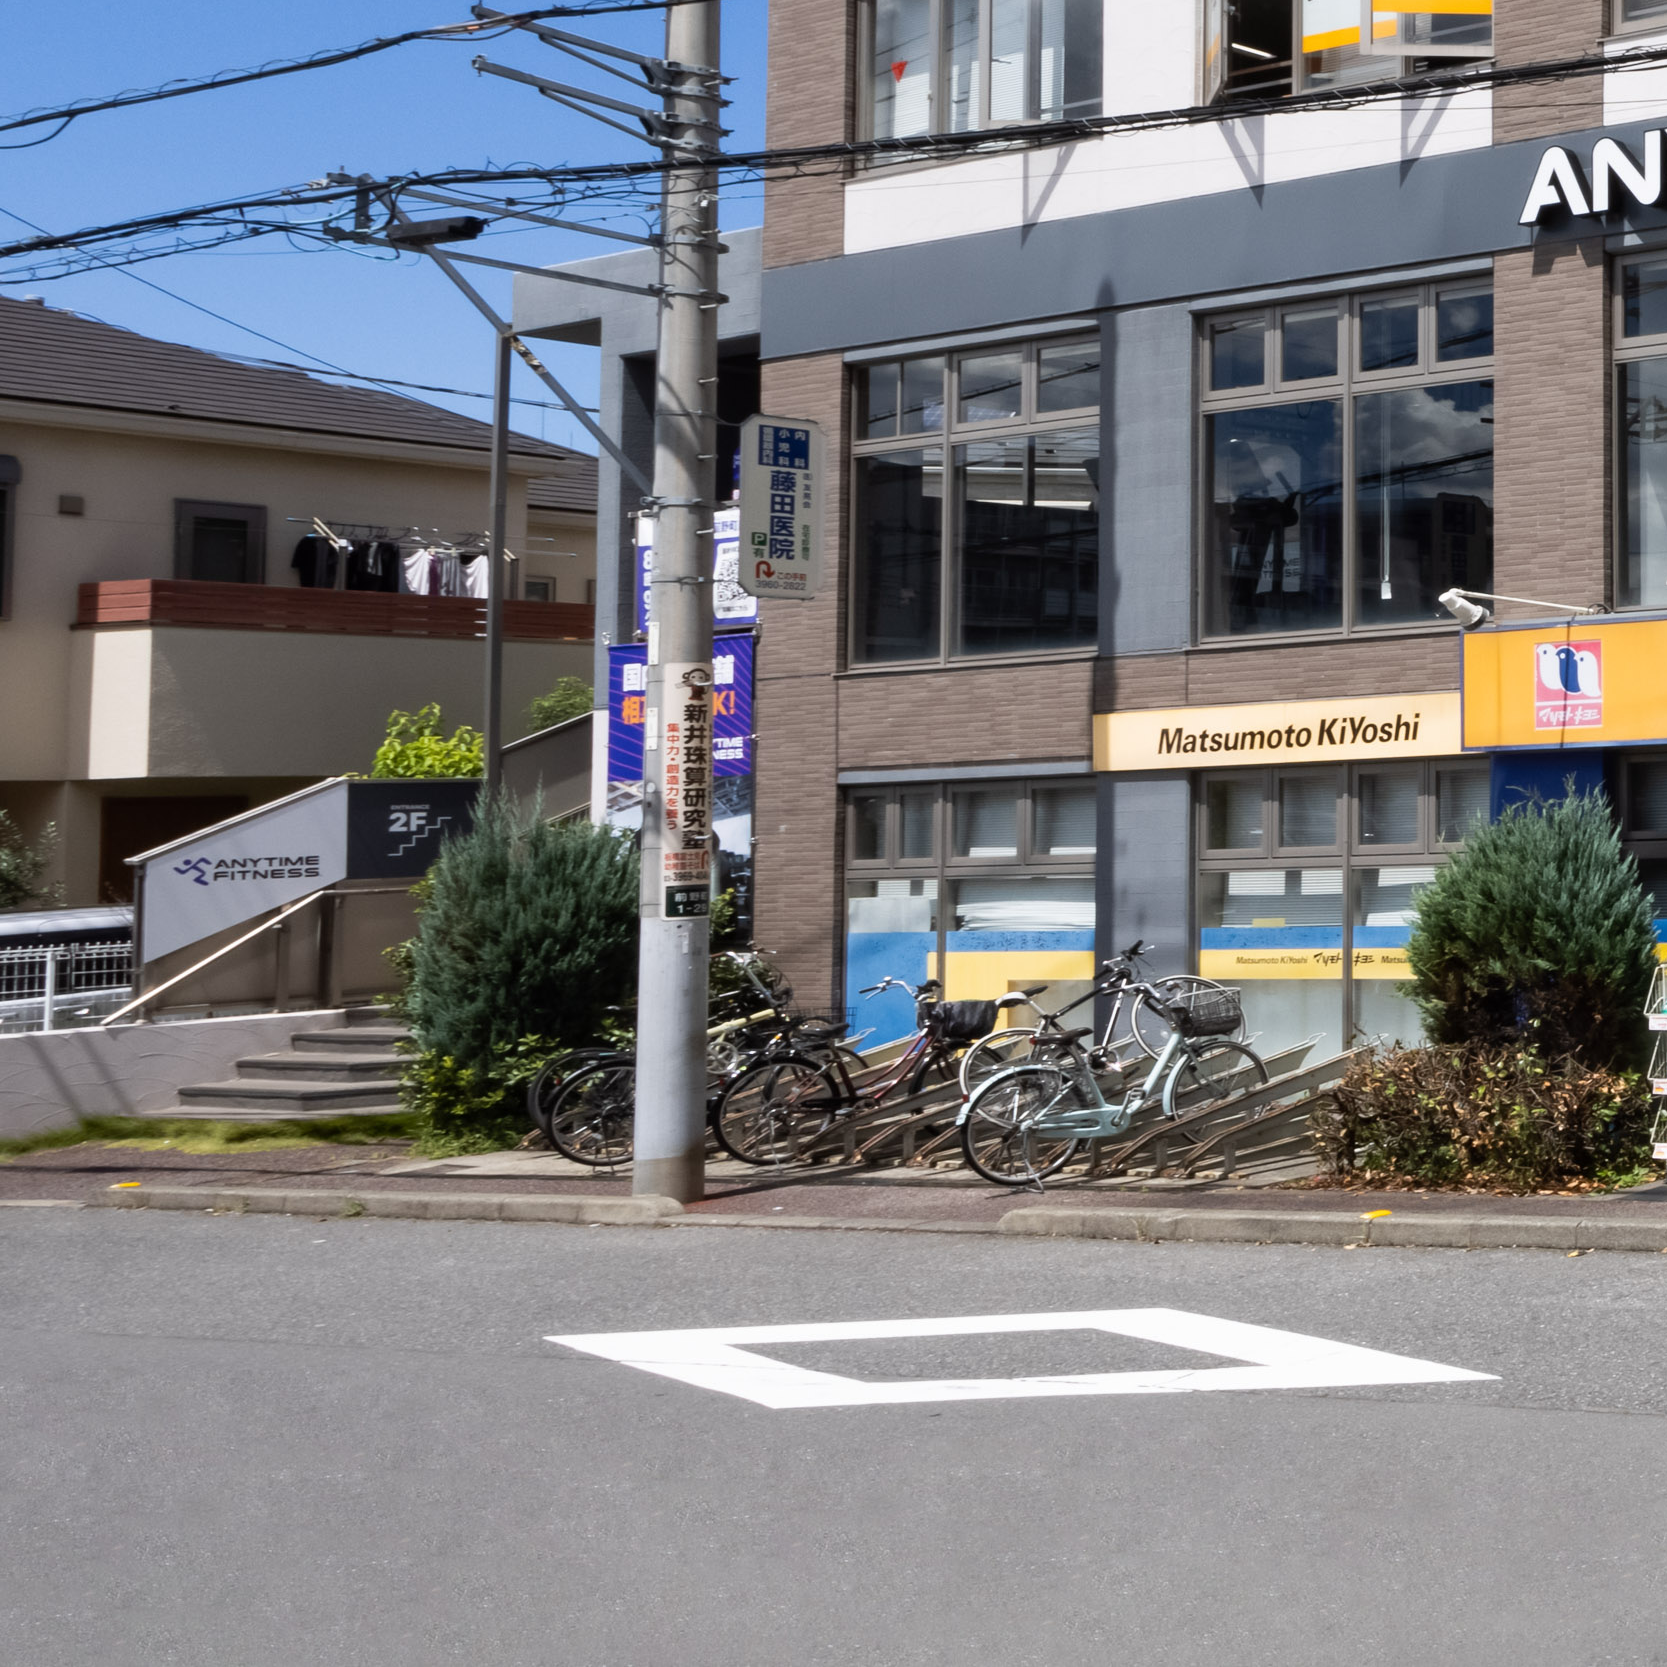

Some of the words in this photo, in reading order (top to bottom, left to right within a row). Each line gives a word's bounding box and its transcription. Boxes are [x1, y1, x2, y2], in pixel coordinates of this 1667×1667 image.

[769, 470, 797, 560] 藤田医院
[1158, 725, 1312, 755] Matsumoto
[1317, 713, 1420, 747] KiYoshi
[681, 703, 708, 851] 新井珠算研究塾
[388, 812, 428, 833] 2F
[213, 867, 320, 882] FITNESS
[214, 855, 320, 868] ANYTIME
